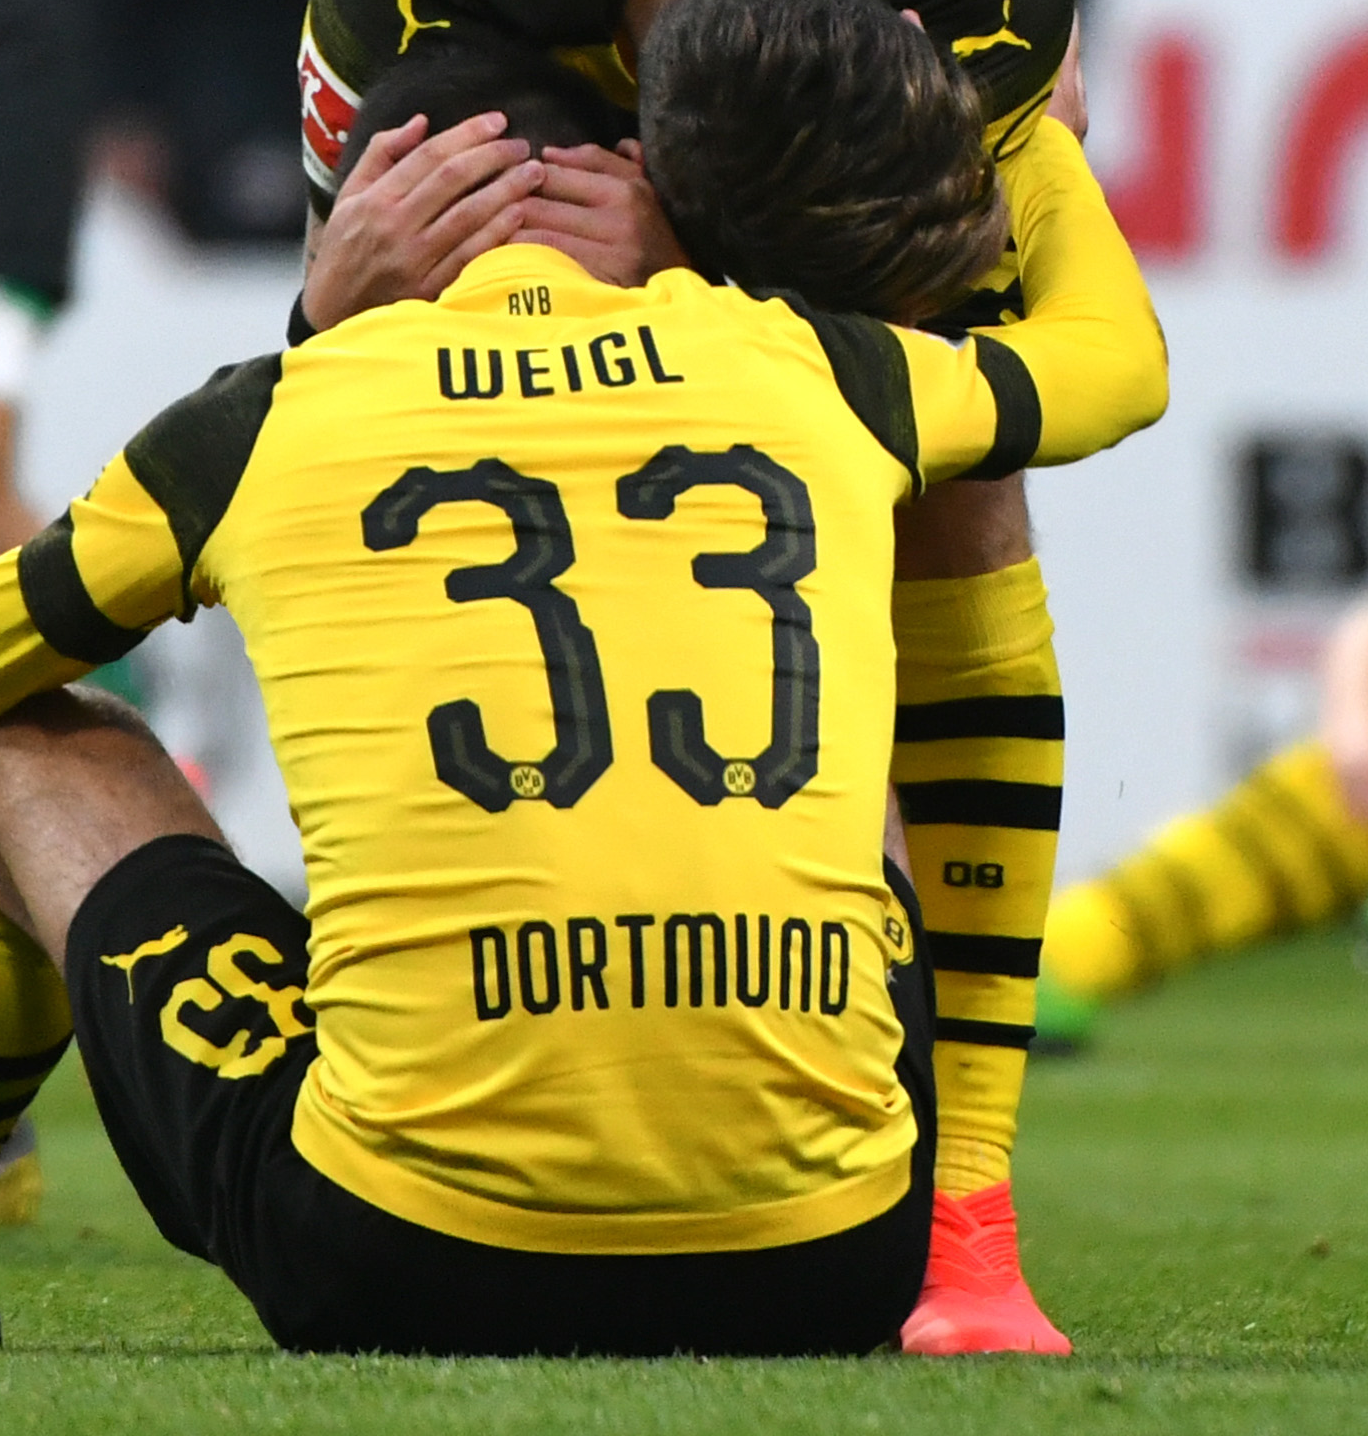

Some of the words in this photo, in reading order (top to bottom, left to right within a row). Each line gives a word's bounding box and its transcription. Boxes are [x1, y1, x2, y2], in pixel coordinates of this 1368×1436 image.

[437, 325, 684, 400] WEIGL
[361, 443, 821, 814] 33
[469, 912, 850, 1020] DORTMUND
